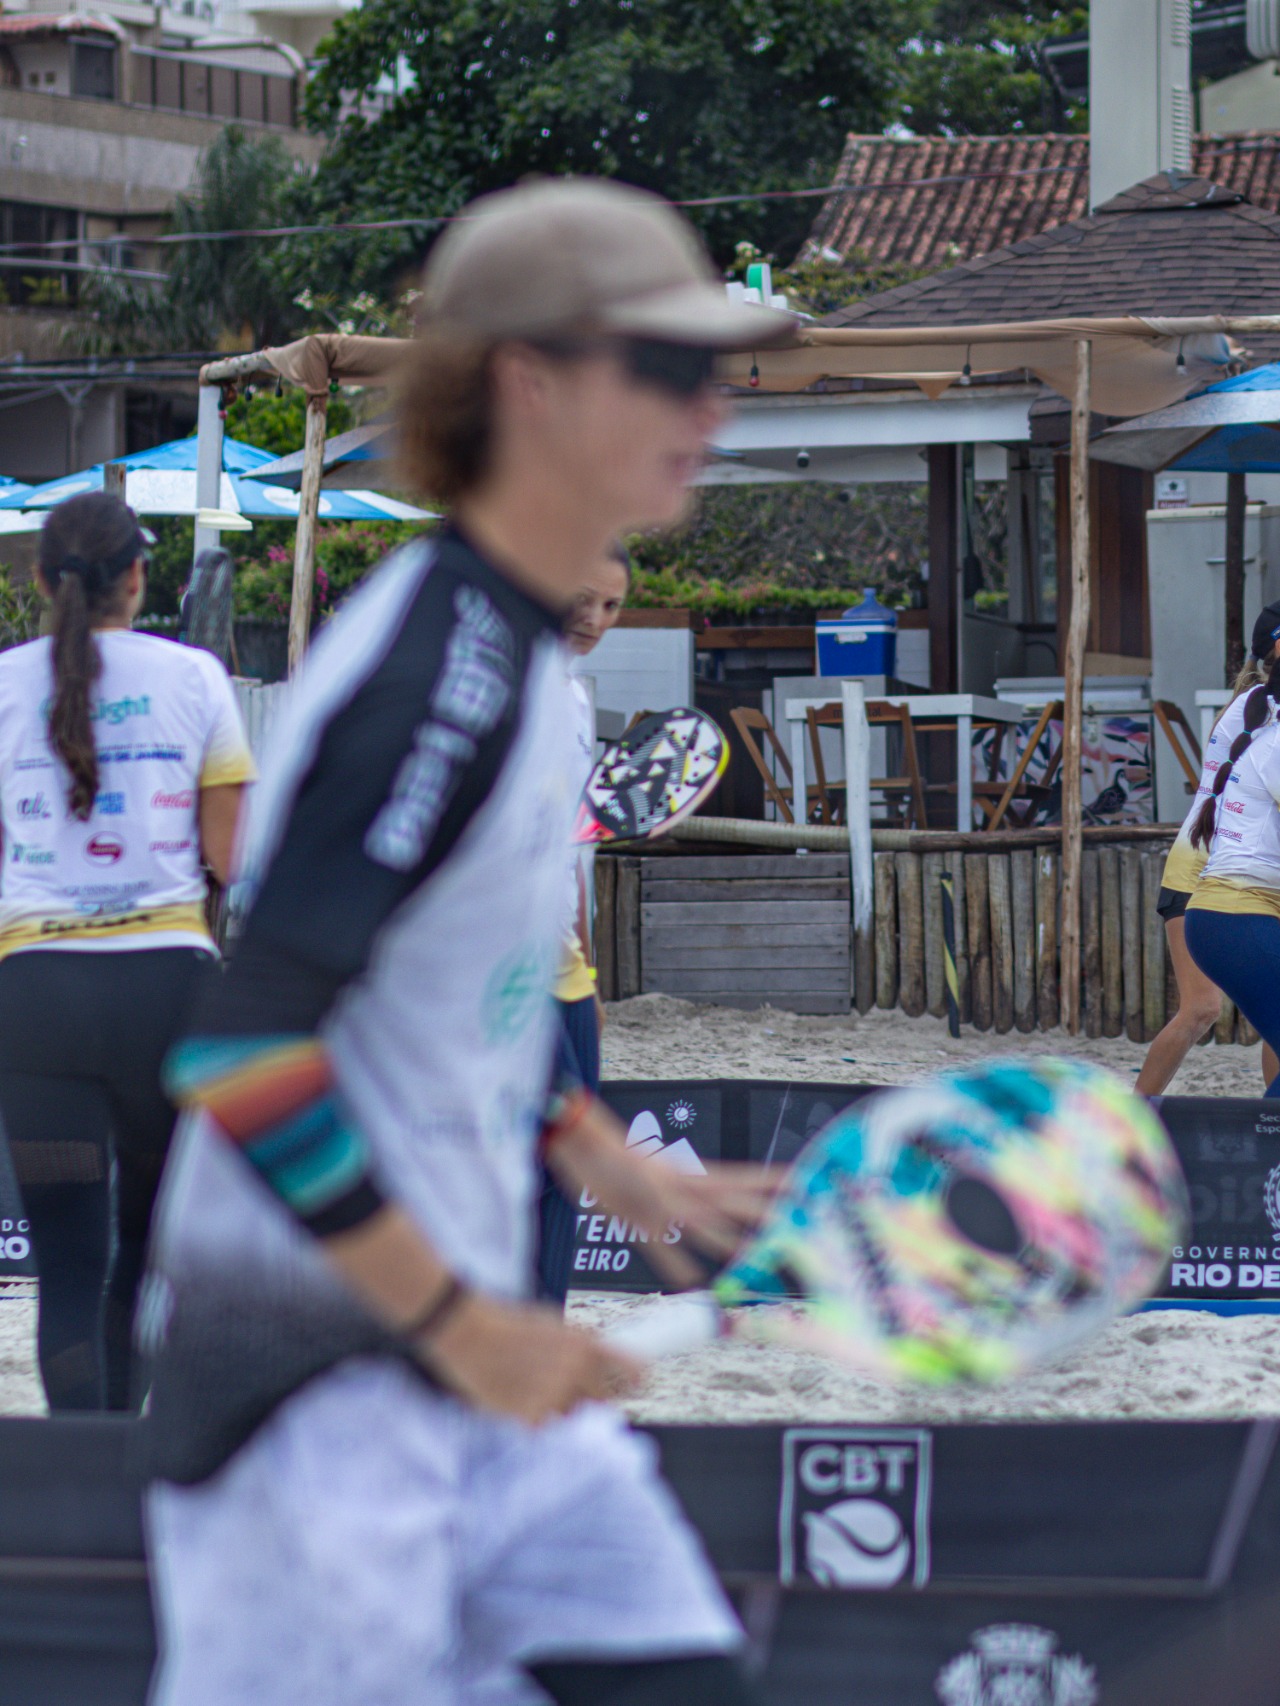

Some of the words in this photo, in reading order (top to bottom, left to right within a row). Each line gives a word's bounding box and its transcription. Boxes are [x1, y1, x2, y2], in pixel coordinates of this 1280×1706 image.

[574, 1248, 630, 1271] EIRO
[1171, 1263, 1232, 1288] RIO
[800, 1443, 914, 1495] CBT
